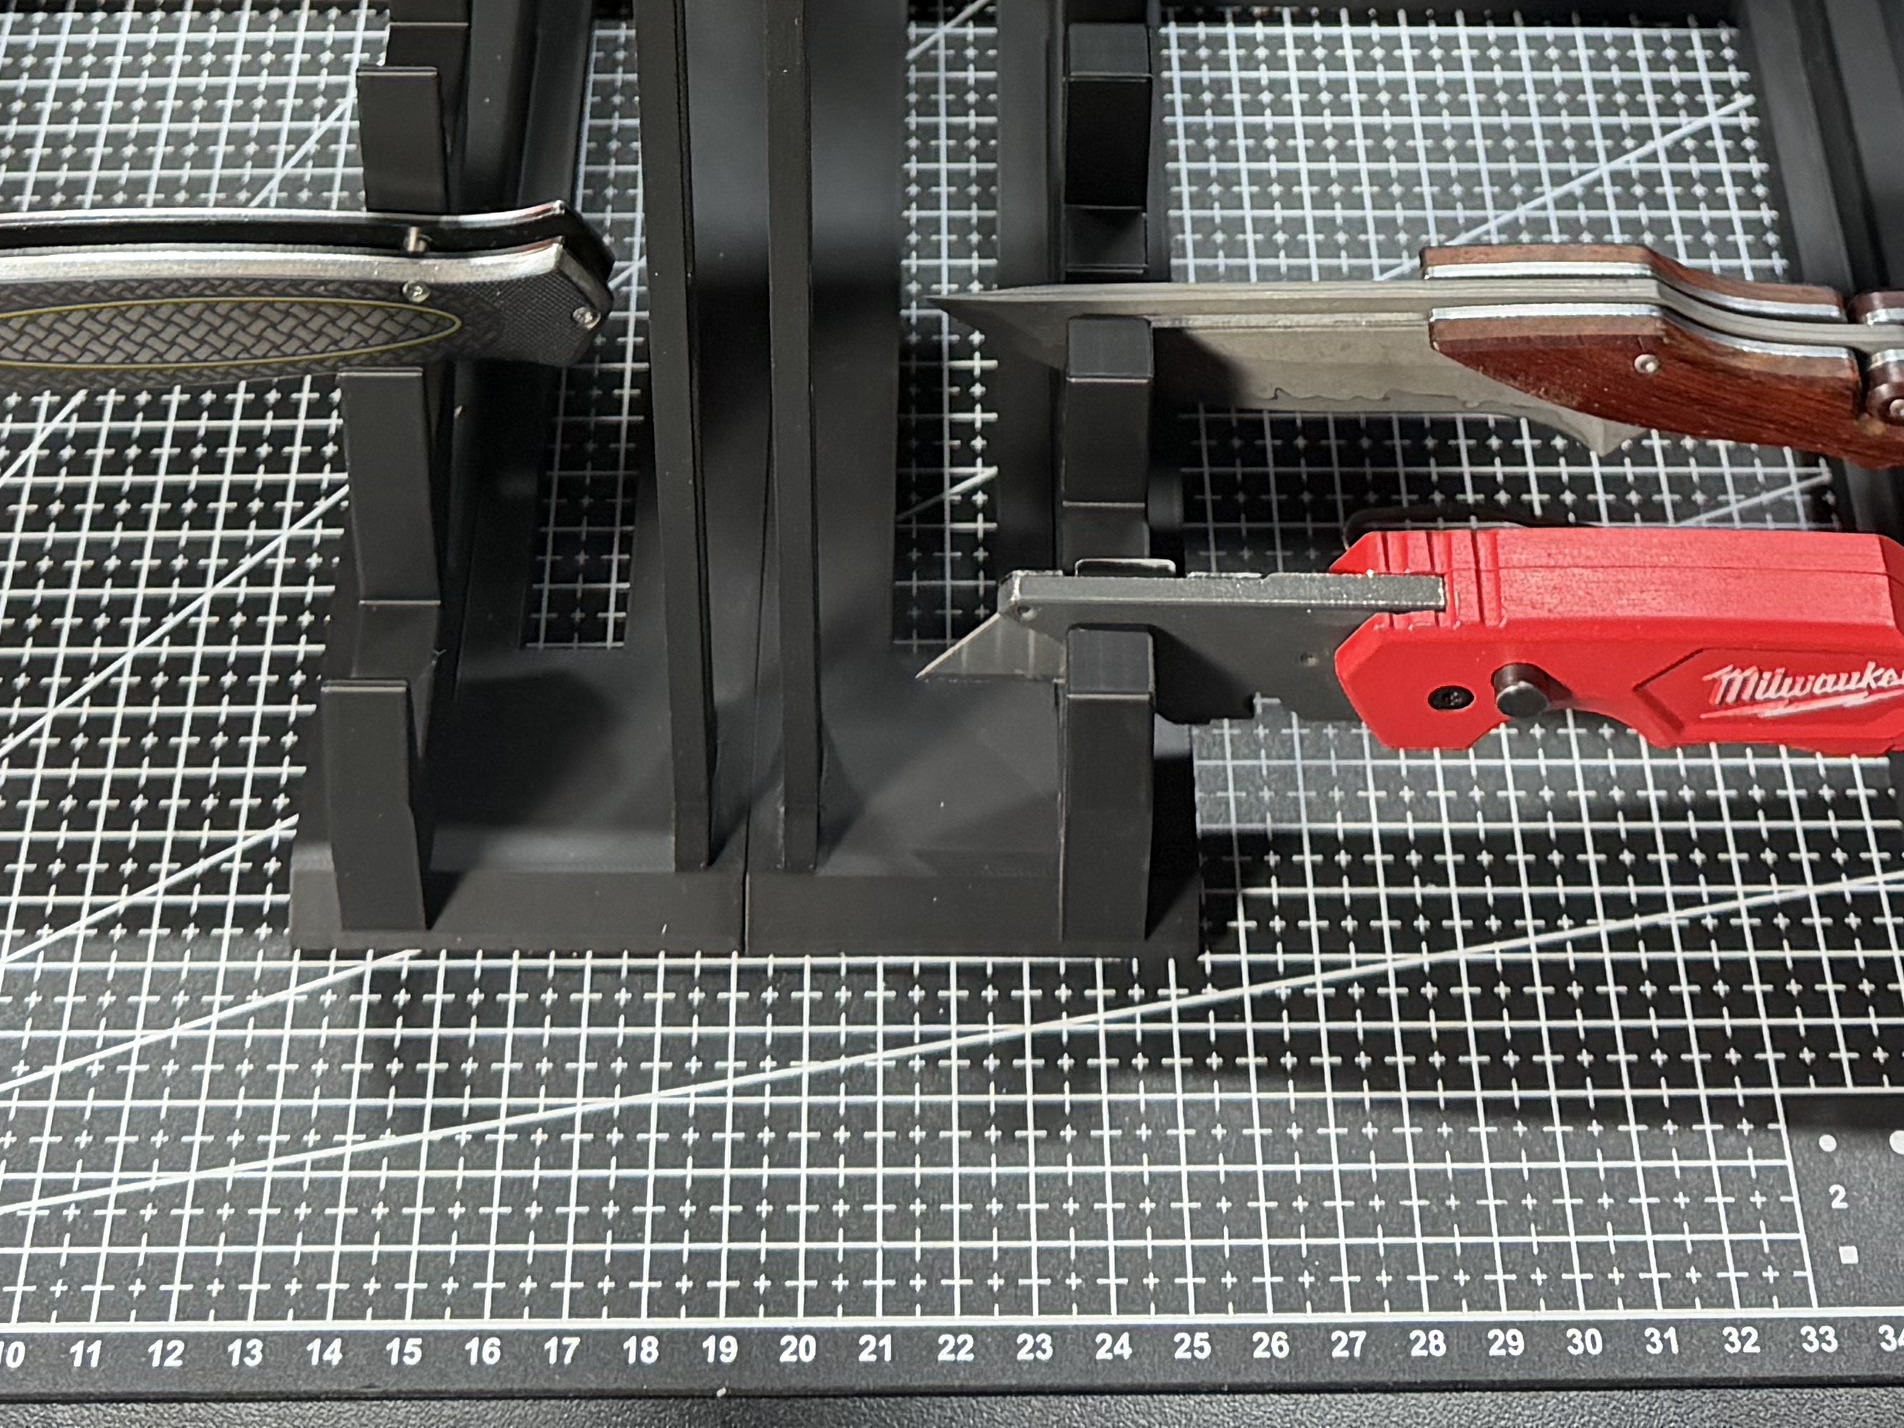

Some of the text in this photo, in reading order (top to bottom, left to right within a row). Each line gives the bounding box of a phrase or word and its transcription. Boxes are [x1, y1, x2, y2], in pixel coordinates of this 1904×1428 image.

[1828, 1183, 1850, 1210] 2
[69, 1339, 103, 1372] 11
[147, 1338, 185, 1369] 12
[227, 1338, 264, 1369] 13
[305, 1337, 344, 1369] 14
[385, 1336, 423, 1367] 15
[464, 1336, 502, 1367] 16
[543, 1335, 581, 1368] 17
[622, 1335, 660, 1365] 18
[702, 1334, 739, 1364] 19
[779, 1334, 817, 1364] 20
[858, 1333, 892, 1364] 21
[937, 1333, 975, 1363] 22
[1016, 1332, 1054, 1363] 23
[1094, 1331, 1133, 1361] 24
[1173, 1331, 1212, 1361] 25
[1252, 1330, 1290, 1359] 26
[1330, 1329, 1368, 1359] 27
[1409, 1328, 1447, 1358] 28
[1487, 1328, 1525, 1357] 29
[1565, 1327, 1603, 1357] 30
[1643, 1326, 1680, 1356] 31
[1721, 1325, 1762, 1355] 32
[1799, 1324, 1839, 1354] 33
